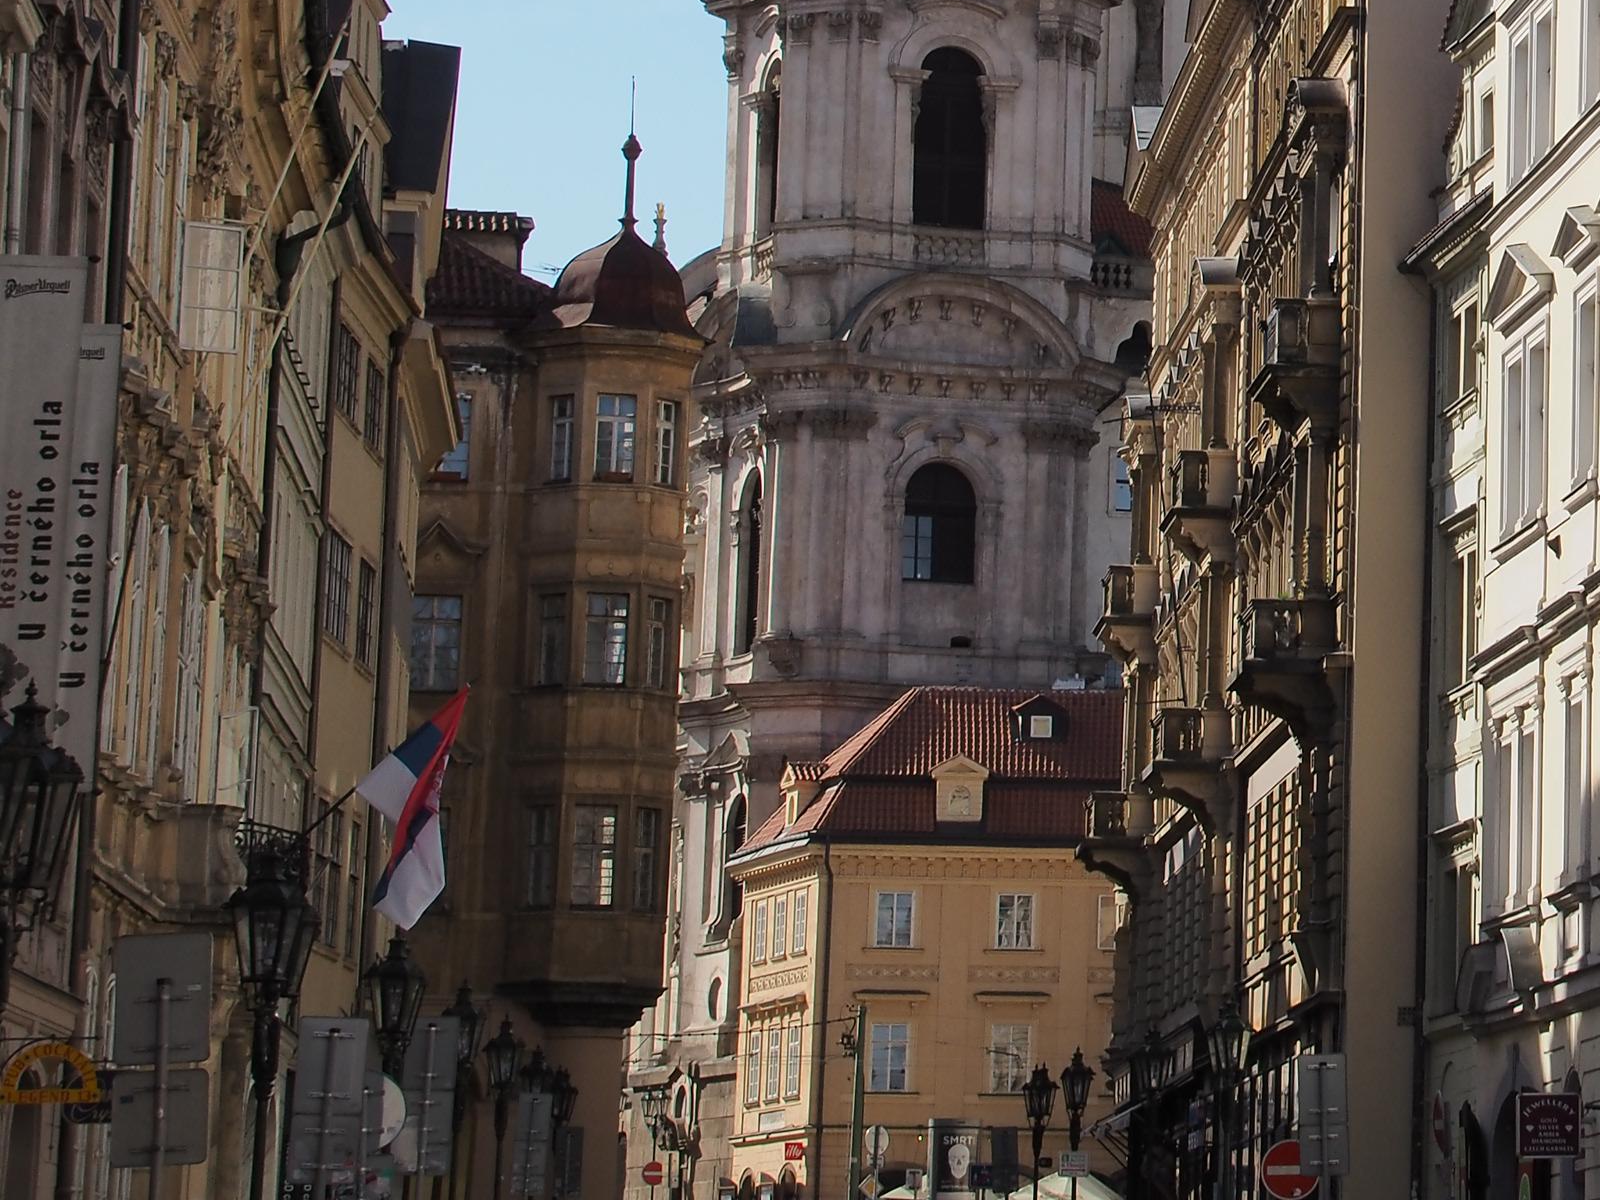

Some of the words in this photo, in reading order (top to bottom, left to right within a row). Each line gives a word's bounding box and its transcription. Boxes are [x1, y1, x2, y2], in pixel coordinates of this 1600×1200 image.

[33, 400, 62, 460] orla
[72, 461, 99, 519] orla
[20, 476, 56, 602] černého
[60, 532, 94, 652] černého
[1523, 1099, 1576, 1117] JEWELLERY
[785, 1144, 802, 1158] illy
